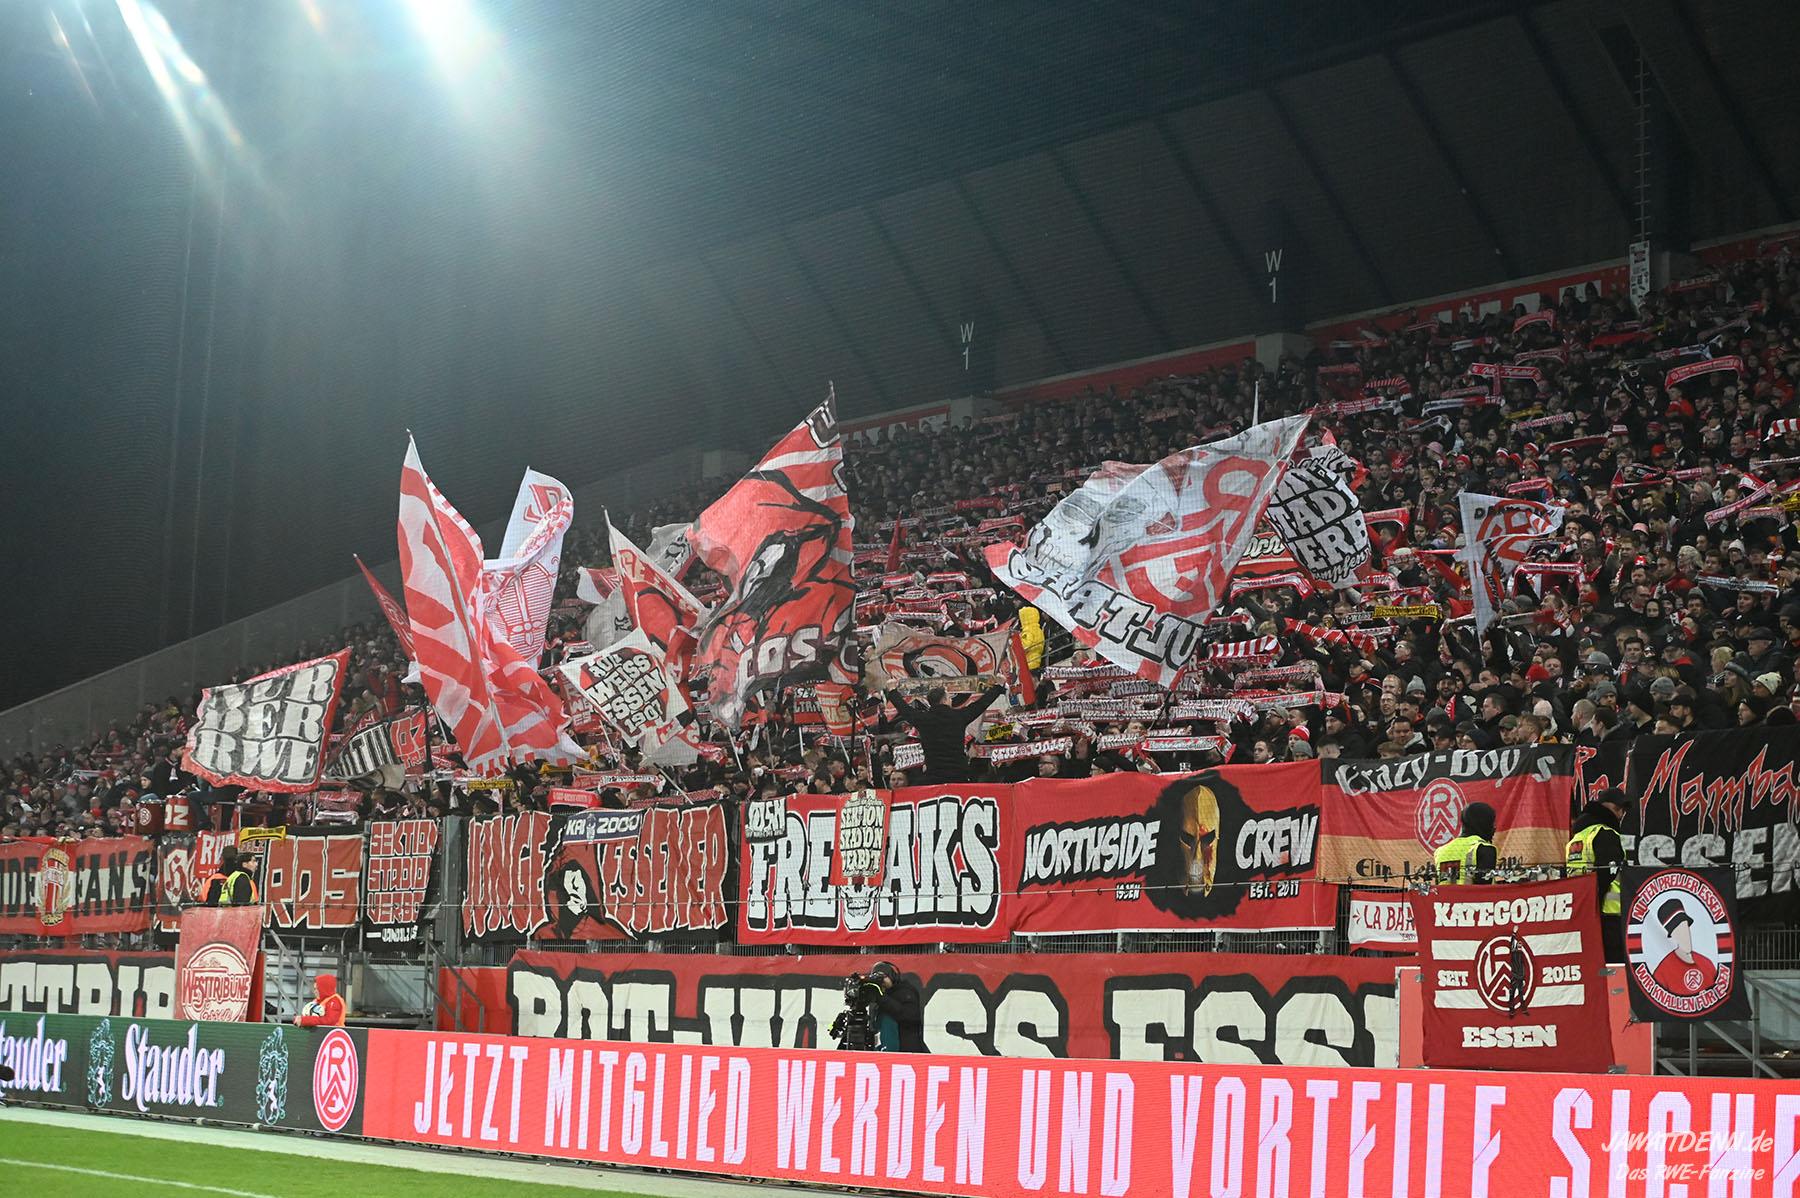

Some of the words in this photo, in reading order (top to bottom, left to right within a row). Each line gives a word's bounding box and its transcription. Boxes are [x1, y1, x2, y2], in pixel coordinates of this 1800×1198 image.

[1265, 249, 1282, 272] W
[1268, 277, 1277, 303] 1
[960, 322, 974, 343] W
[962, 346, 969, 370] 1
[586, 655, 651, 704] WEISS
[625, 699, 663, 733] 1907
[1640, 739, 1800, 837] Mamba
[597, 814, 639, 834] 2000
[1235, 812, 1319, 870] CREW
[463, 810, 553, 938] JUNGE
[602, 804, 729, 936] ESSENER
[747, 797, 998, 928] FREAKS
[1023, 820, 1161, 883] NORTHSIDE
[73, 850, 151, 918] FANS
[1250, 884, 1273, 899] EST.
[1656, 873, 1702, 895] PRELLER
[1697, 883, 1726, 923] ESSEN
[1363, 904, 1382, 932] LA
[1433, 893, 1573, 928] KATEGORIE
[182, 967, 251, 1009] WESTTRIBÜNE
[1437, 970, 1469, 987] SEIT
[1541, 965, 1582, 984] 2015
[1635, 963, 1654, 994] WIR
[1652, 984, 1697, 1012] KNALLEN
[1696, 987, 1717, 1010] FÜR
[1460, 1025, 1558, 1048] ESSEN
[121, 1022, 225, 1112] Stauder
[413, 1040, 528, 1143] JETZT
[544, 1047, 751, 1165] MITGLIED
[777, 1059, 988, 1186] WERDEN
[1017, 1069, 1135, 1197] UND
